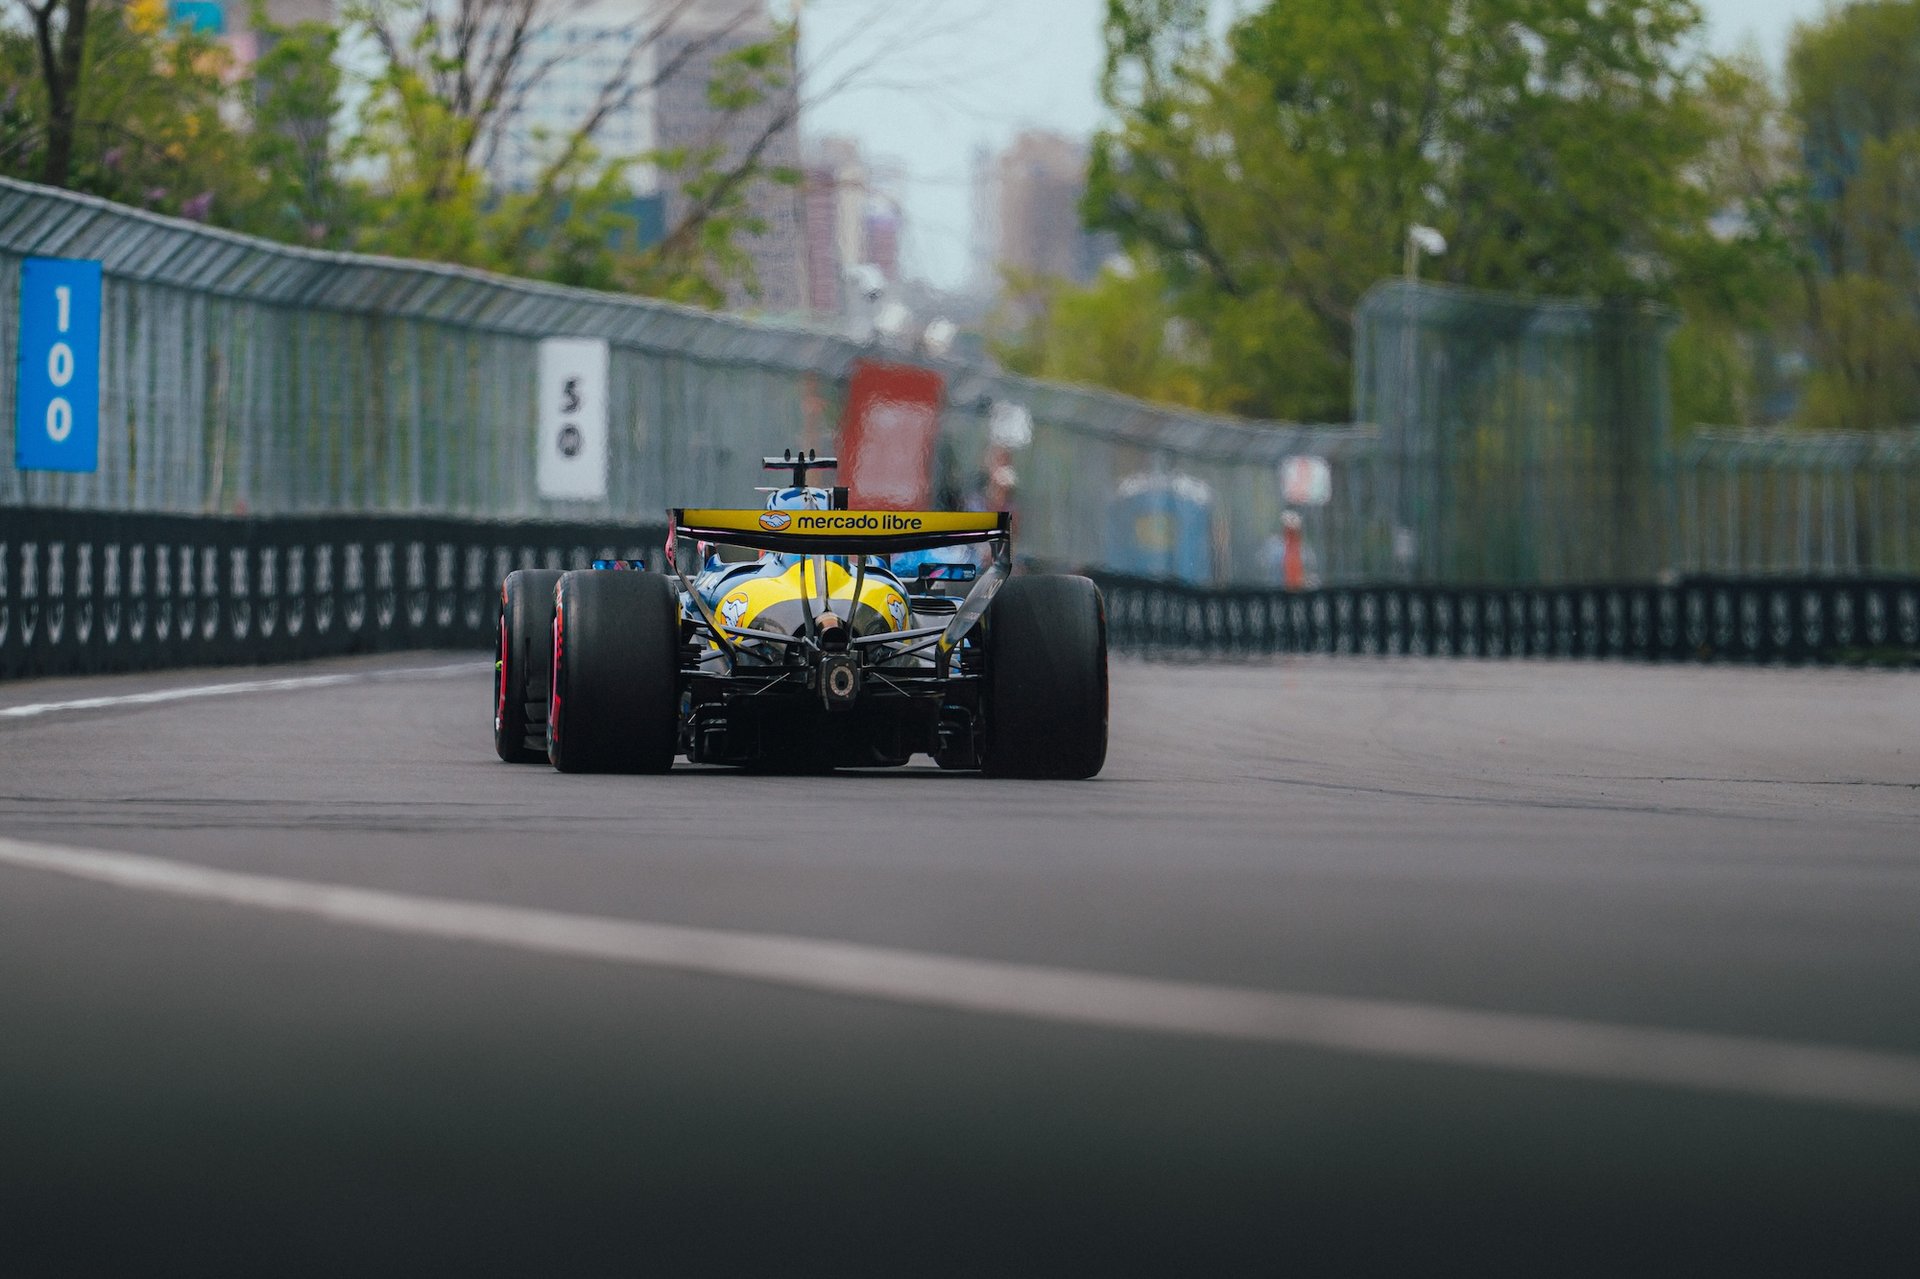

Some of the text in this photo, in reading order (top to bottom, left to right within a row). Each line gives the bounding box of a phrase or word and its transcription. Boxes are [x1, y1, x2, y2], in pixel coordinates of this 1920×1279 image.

[47, 285, 74, 442] 100
[557, 377, 583, 458] 50
[797, 514, 922, 530] mercado libre
